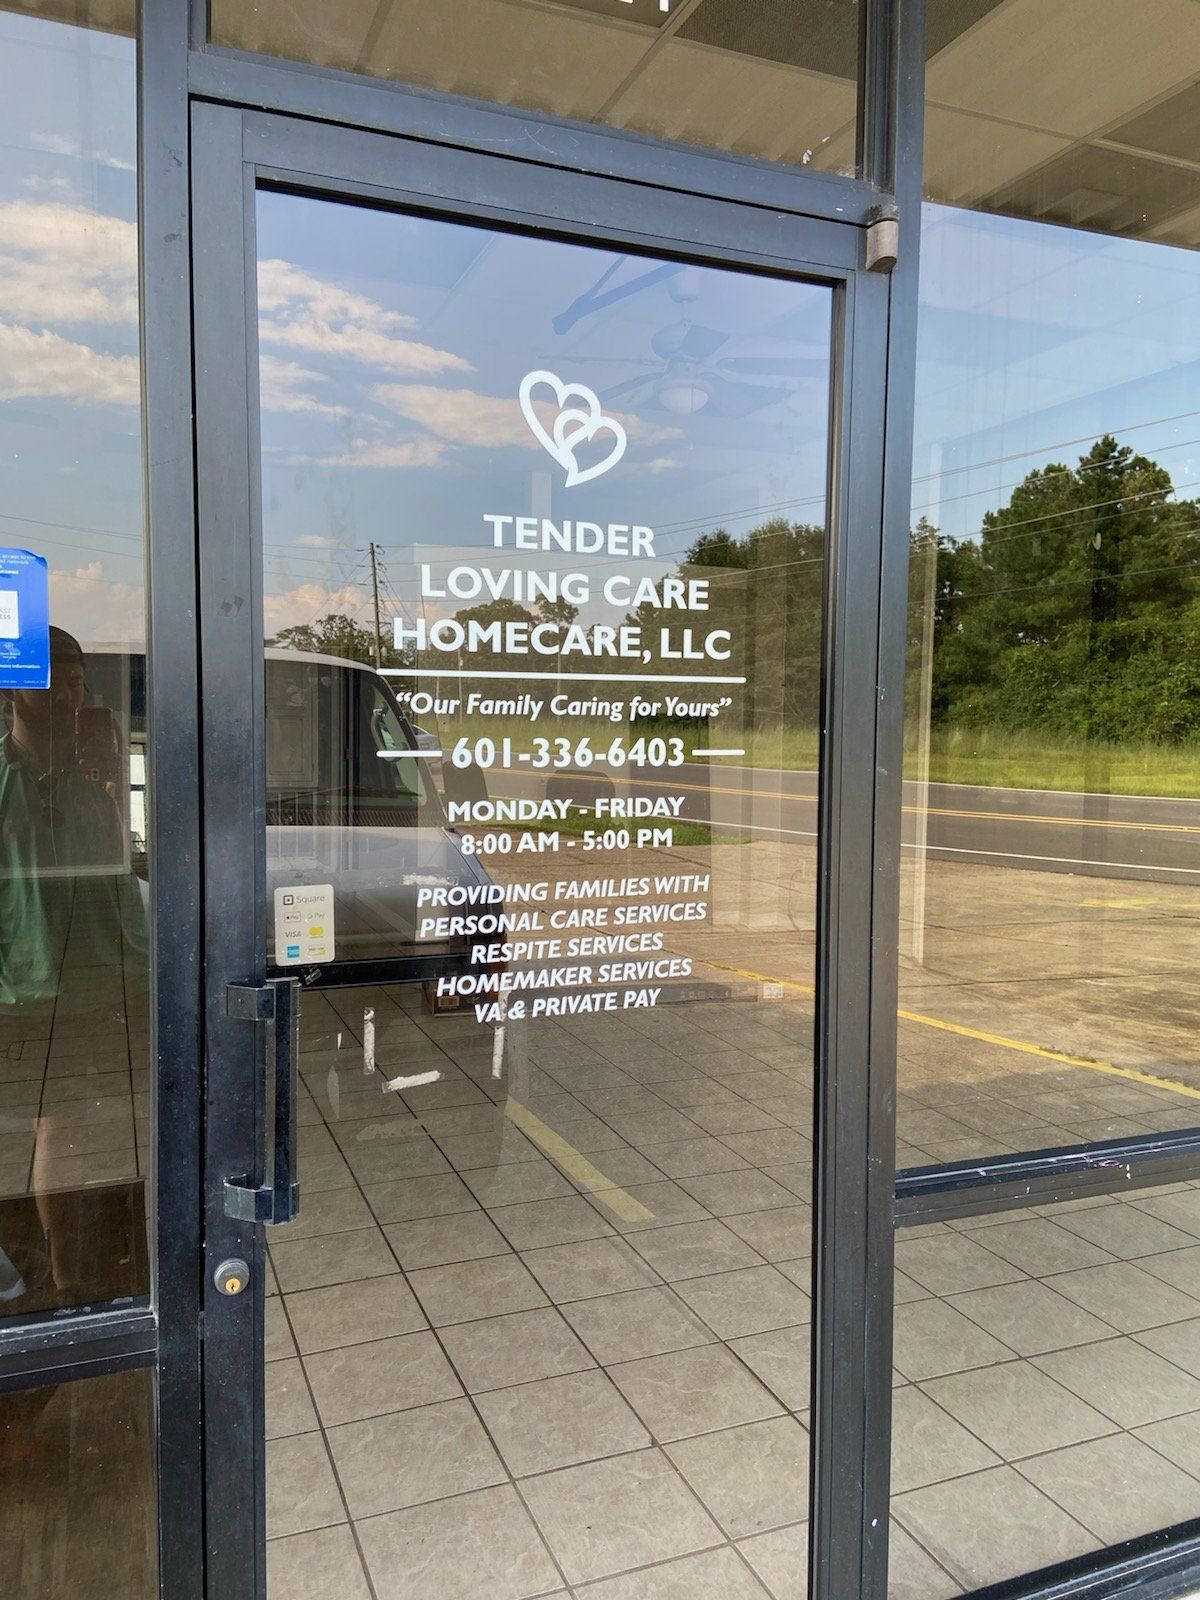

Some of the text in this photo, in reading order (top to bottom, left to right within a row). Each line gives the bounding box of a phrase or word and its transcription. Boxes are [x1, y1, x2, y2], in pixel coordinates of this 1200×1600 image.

[483, 513, 656, 557] TENDER
[421, 564, 710, 611] LOVING CARE
[394, 617, 731, 664] HOMECARE, LLC
[396, 692, 732, 722] “Our Family Caring for Yours”
[451, 737, 685, 769] 601-336-6403
[448, 798, 573, 822] MONDAY
[595, 796, 686, 819] FRIDAY
[460, 833, 512, 856] 8:00
[516, 831, 560, 853] AM
[582, 829, 630, 851] 5:00
[637, 828, 673, 849] PM
[296, 896, 325, 904] Square
[416, 874, 711, 908] PROVIDING FAMILIES WITH
[419, 901, 708, 938] PERSONAL CARE SERVICES
[470, 931, 664, 964] RESPITE SERVICES
[436, 957, 693, 997] HOMEMAKER SERVICES
[474, 987, 662, 1023] VA & PRIVATE PAY
